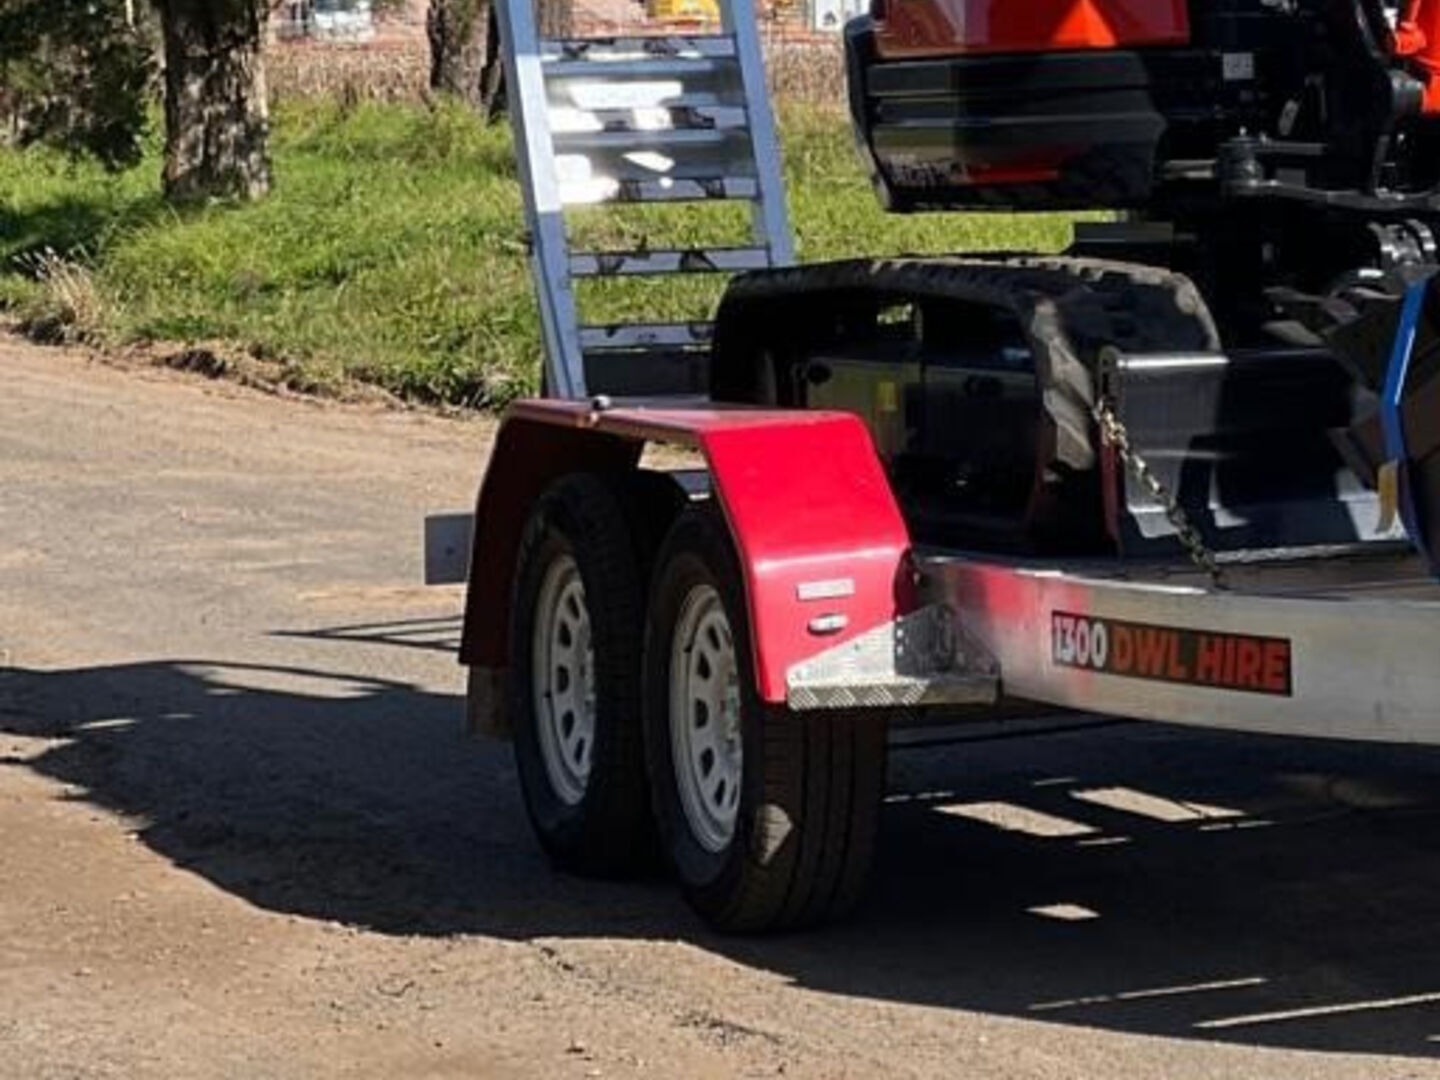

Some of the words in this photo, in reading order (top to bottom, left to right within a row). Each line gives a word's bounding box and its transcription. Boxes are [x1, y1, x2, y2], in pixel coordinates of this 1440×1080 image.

[1053, 615, 1107, 668] 1300
[1113, 626, 1187, 678] DWL
[1197, 635, 1288, 694] HIRE
